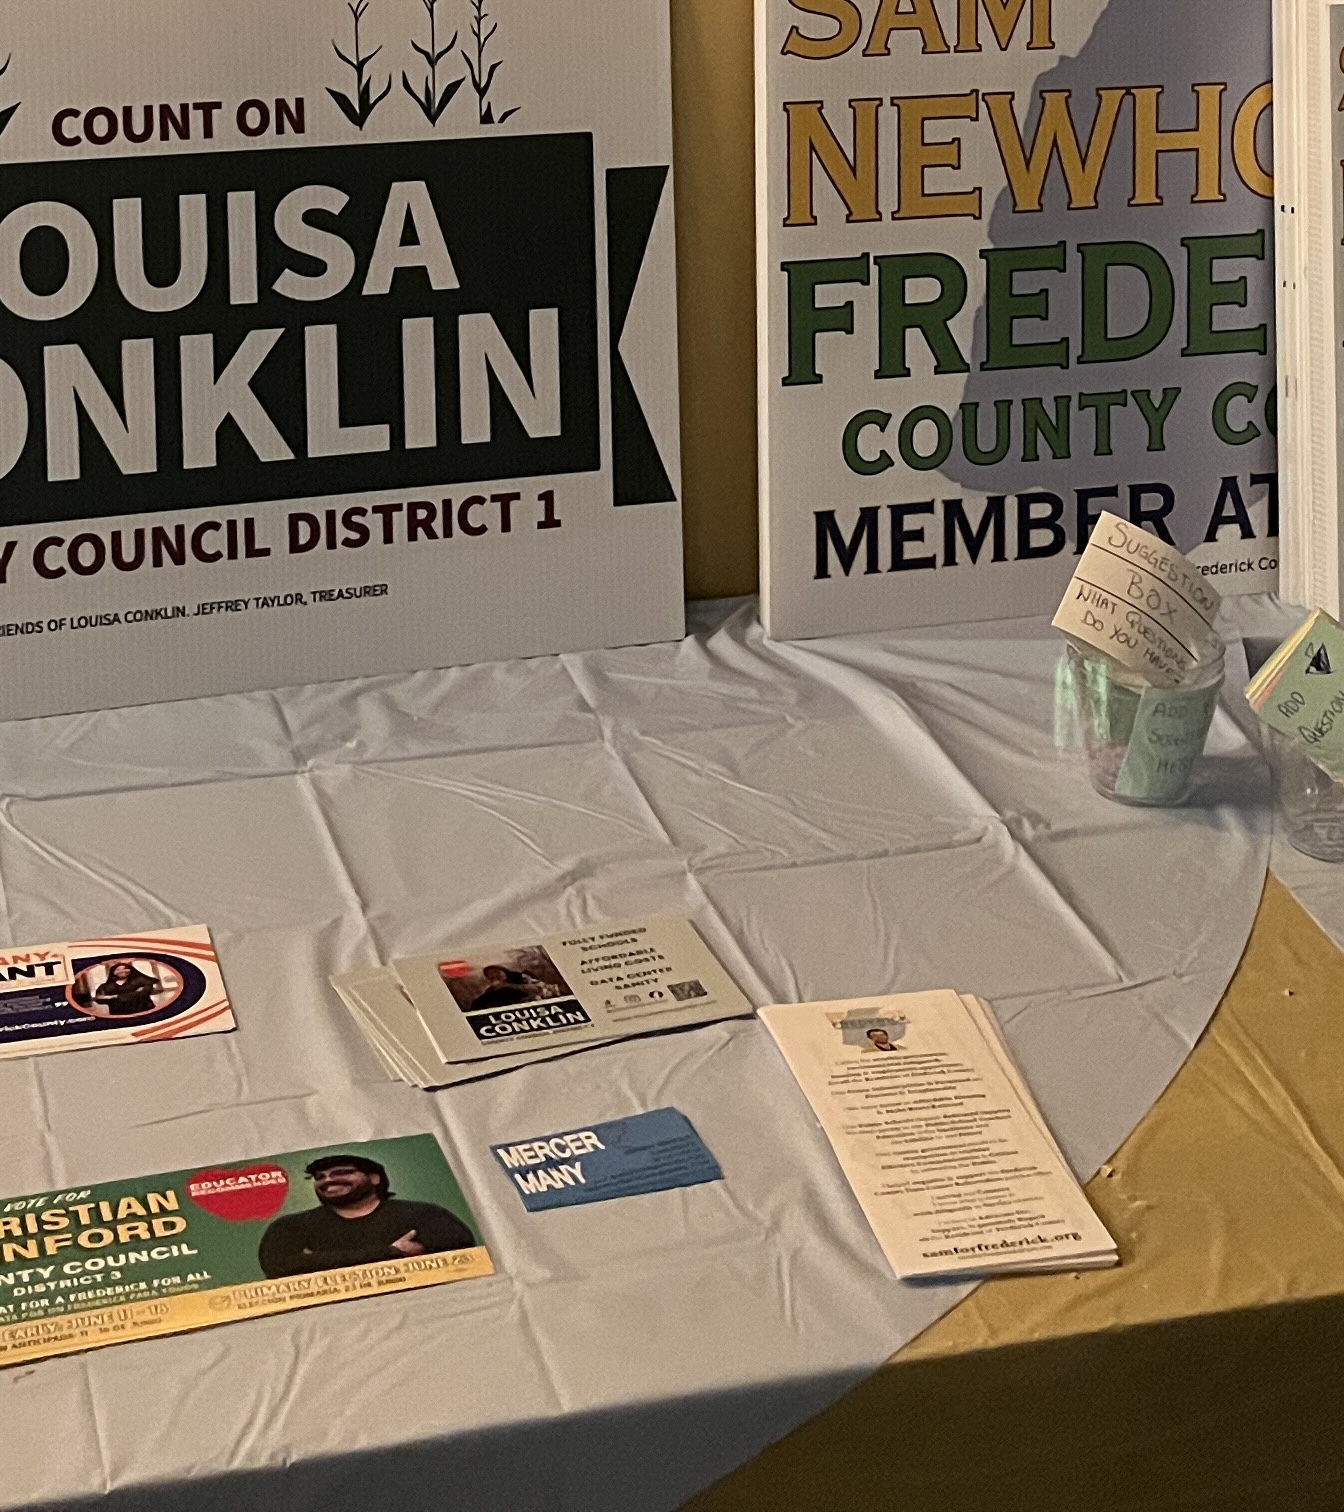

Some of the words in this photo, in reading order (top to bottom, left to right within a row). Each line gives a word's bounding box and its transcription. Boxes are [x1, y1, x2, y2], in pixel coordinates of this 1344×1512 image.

[51, 101, 223, 147] COUNT
[235, 95, 306, 137] ON
[781, 230, 1268, 387] FREDE
[841, 384, 1181, 478] COUNTY
[31, 516, 272, 580] COUNCIL
[287, 494, 521, 555] DISTRICT
[535, 489, 562, 530] 1
[812, 483, 1176, 581] MEMBER
[1107, 521, 1215, 611] SUGGESTION
[47, 617, 67, 632] OF
[70, 612, 122, 630] LOUISA
[193, 598, 251, 616] JEFFREY
[253, 593, 308, 610] TAYLOR,
[310, 583, 389, 603] TREASURER
[1076, 584, 1118, 615] WHAT
[1126, 568, 1179, 625] BOX
[1081, 609, 1105, 632] DO
[1108, 624, 1139, 649] YOU
[1277, 690, 1306, 719] ADD
[479, 1011, 587, 1037] CONKLIN
[487, 1004, 564, 1025] LOUISA
[496, 1130, 606, 1169] MERCER
[189, 1171, 285, 1193] EDUCATOR
[513, 1161, 587, 1195] MANY
[4, 1197, 47, 1213] VOTE
[52, 1189, 91, 1205] FOR
[62, 1243, 199, 1275] COUNCIL
[922, 1232, 1082, 1258] samforfrederick.org
[13, 1274, 106, 1298] DISTRICT
[110, 1271, 122, 1281] 3
[21, 1298, 50, 1311] FOR
[55, 1295, 66, 1305] A
[69, 1281, 149, 1303] FREDERICK
[153, 1276, 181, 1287] FOR
[186, 1271, 212, 1281] ALL
